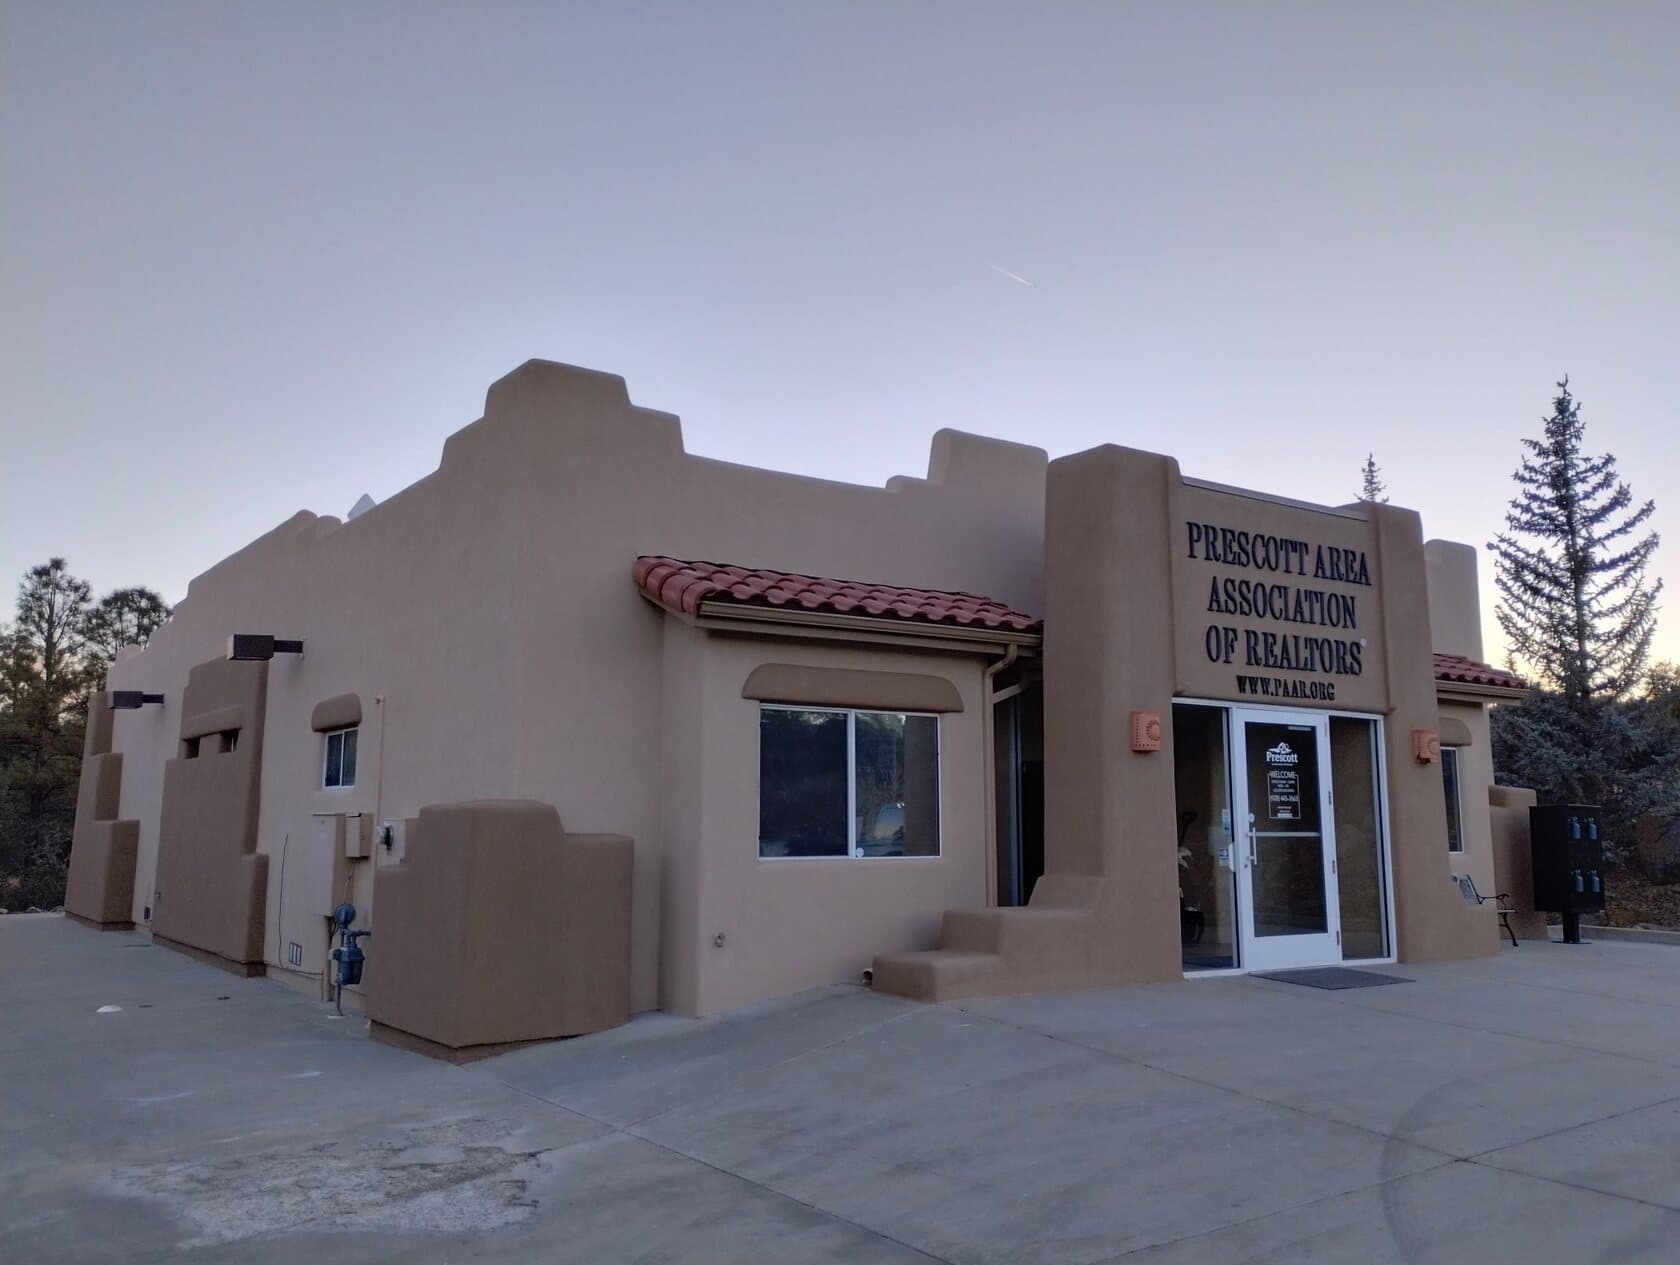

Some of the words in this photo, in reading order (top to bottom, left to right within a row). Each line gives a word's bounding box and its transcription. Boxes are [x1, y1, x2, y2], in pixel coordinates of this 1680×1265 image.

[1187, 522, 1309, 575] PRESCOTT
[1314, 545, 1372, 586] AREA
[1207, 576, 1356, 629] ASSOCIATION
[1206, 625, 1238, 663] OF
[1245, 630, 1362, 676] REALTORS
[1236, 675, 1336, 700] WWW.PAAR.ORG
[1266, 751, 1298, 763] Prescott
[1270, 771, 1296, 779] WELCOME
